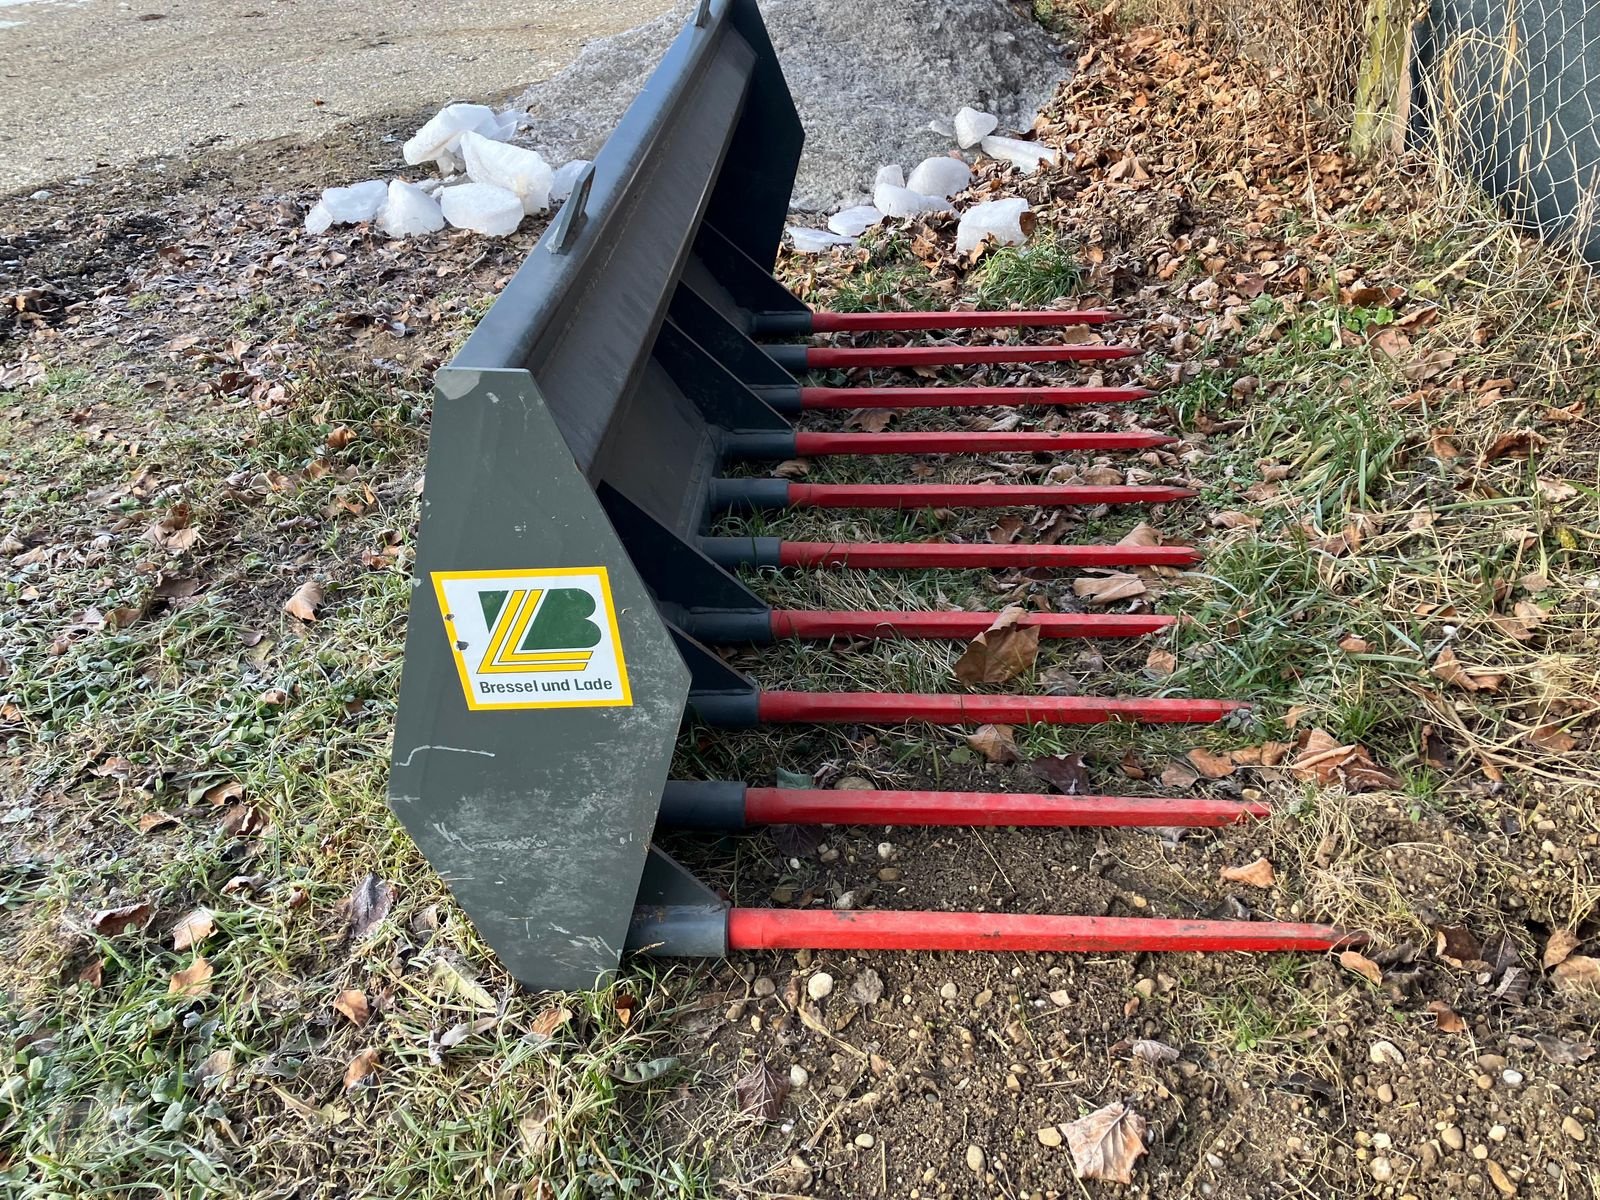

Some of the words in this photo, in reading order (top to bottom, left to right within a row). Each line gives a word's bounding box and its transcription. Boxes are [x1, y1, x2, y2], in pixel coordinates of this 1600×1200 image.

[479, 680, 538, 694] Bressel
[541, 678, 570, 692] und
[574, 677, 613, 691] Lade
